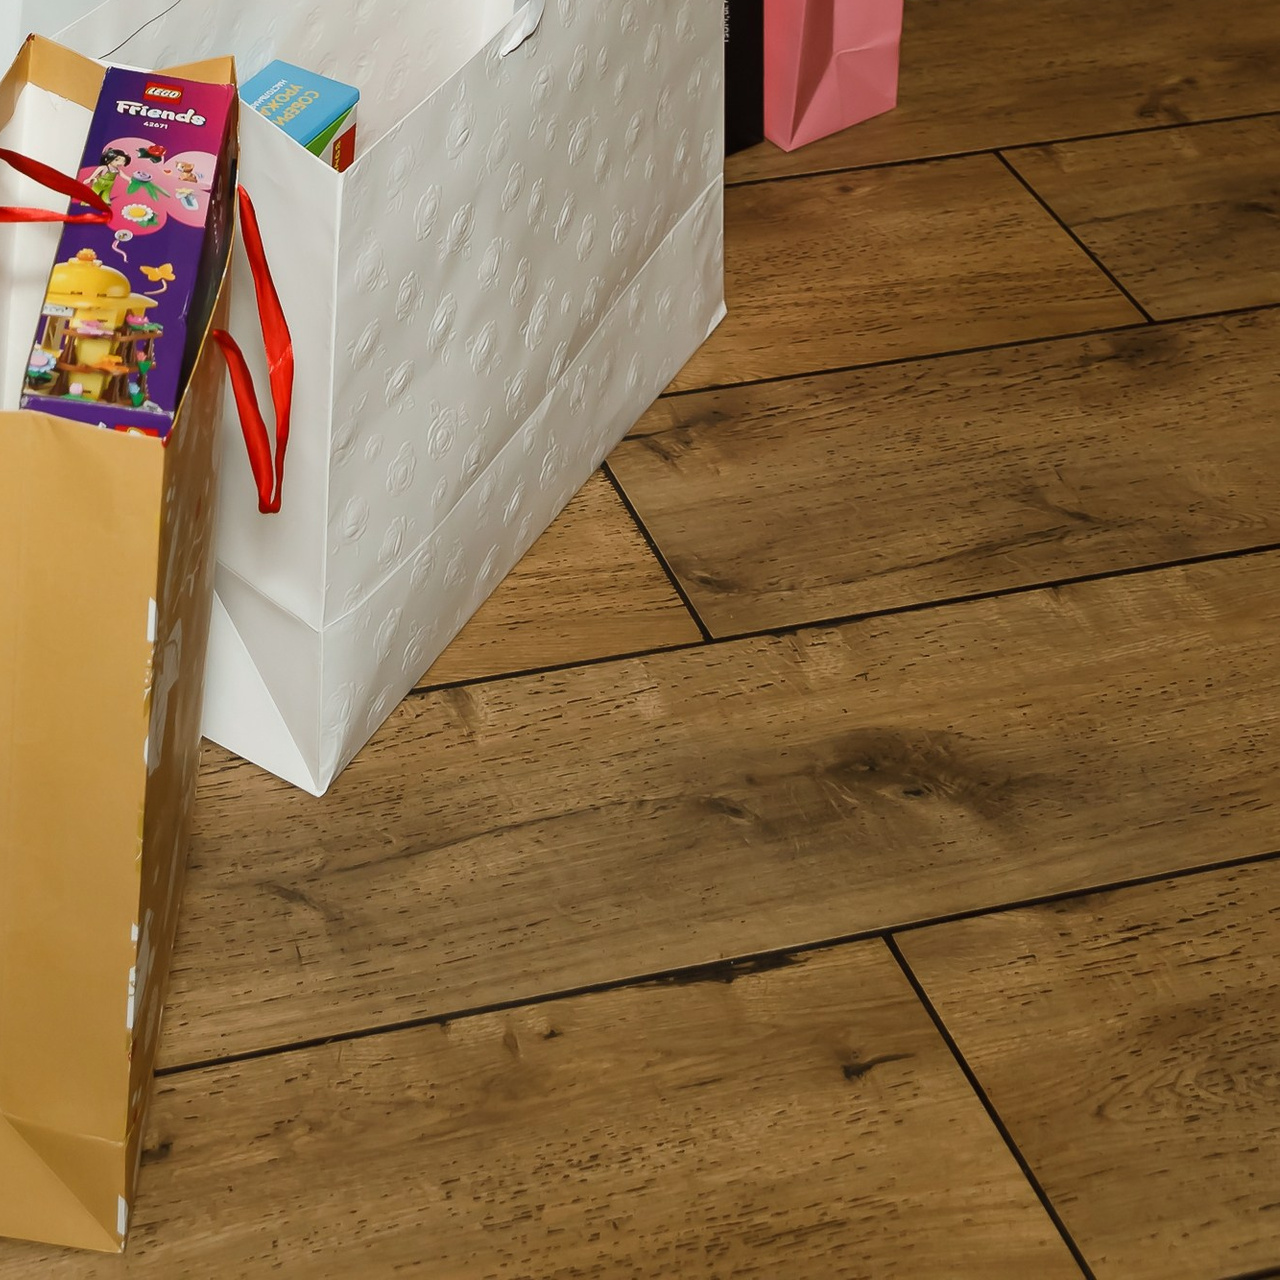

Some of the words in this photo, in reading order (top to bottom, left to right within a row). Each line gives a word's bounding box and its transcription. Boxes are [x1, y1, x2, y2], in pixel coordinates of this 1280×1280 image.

[145, 86, 182, 99] LEGO
[116, 100, 206, 127] Friends
[143, 121, 169, 130] 42671
